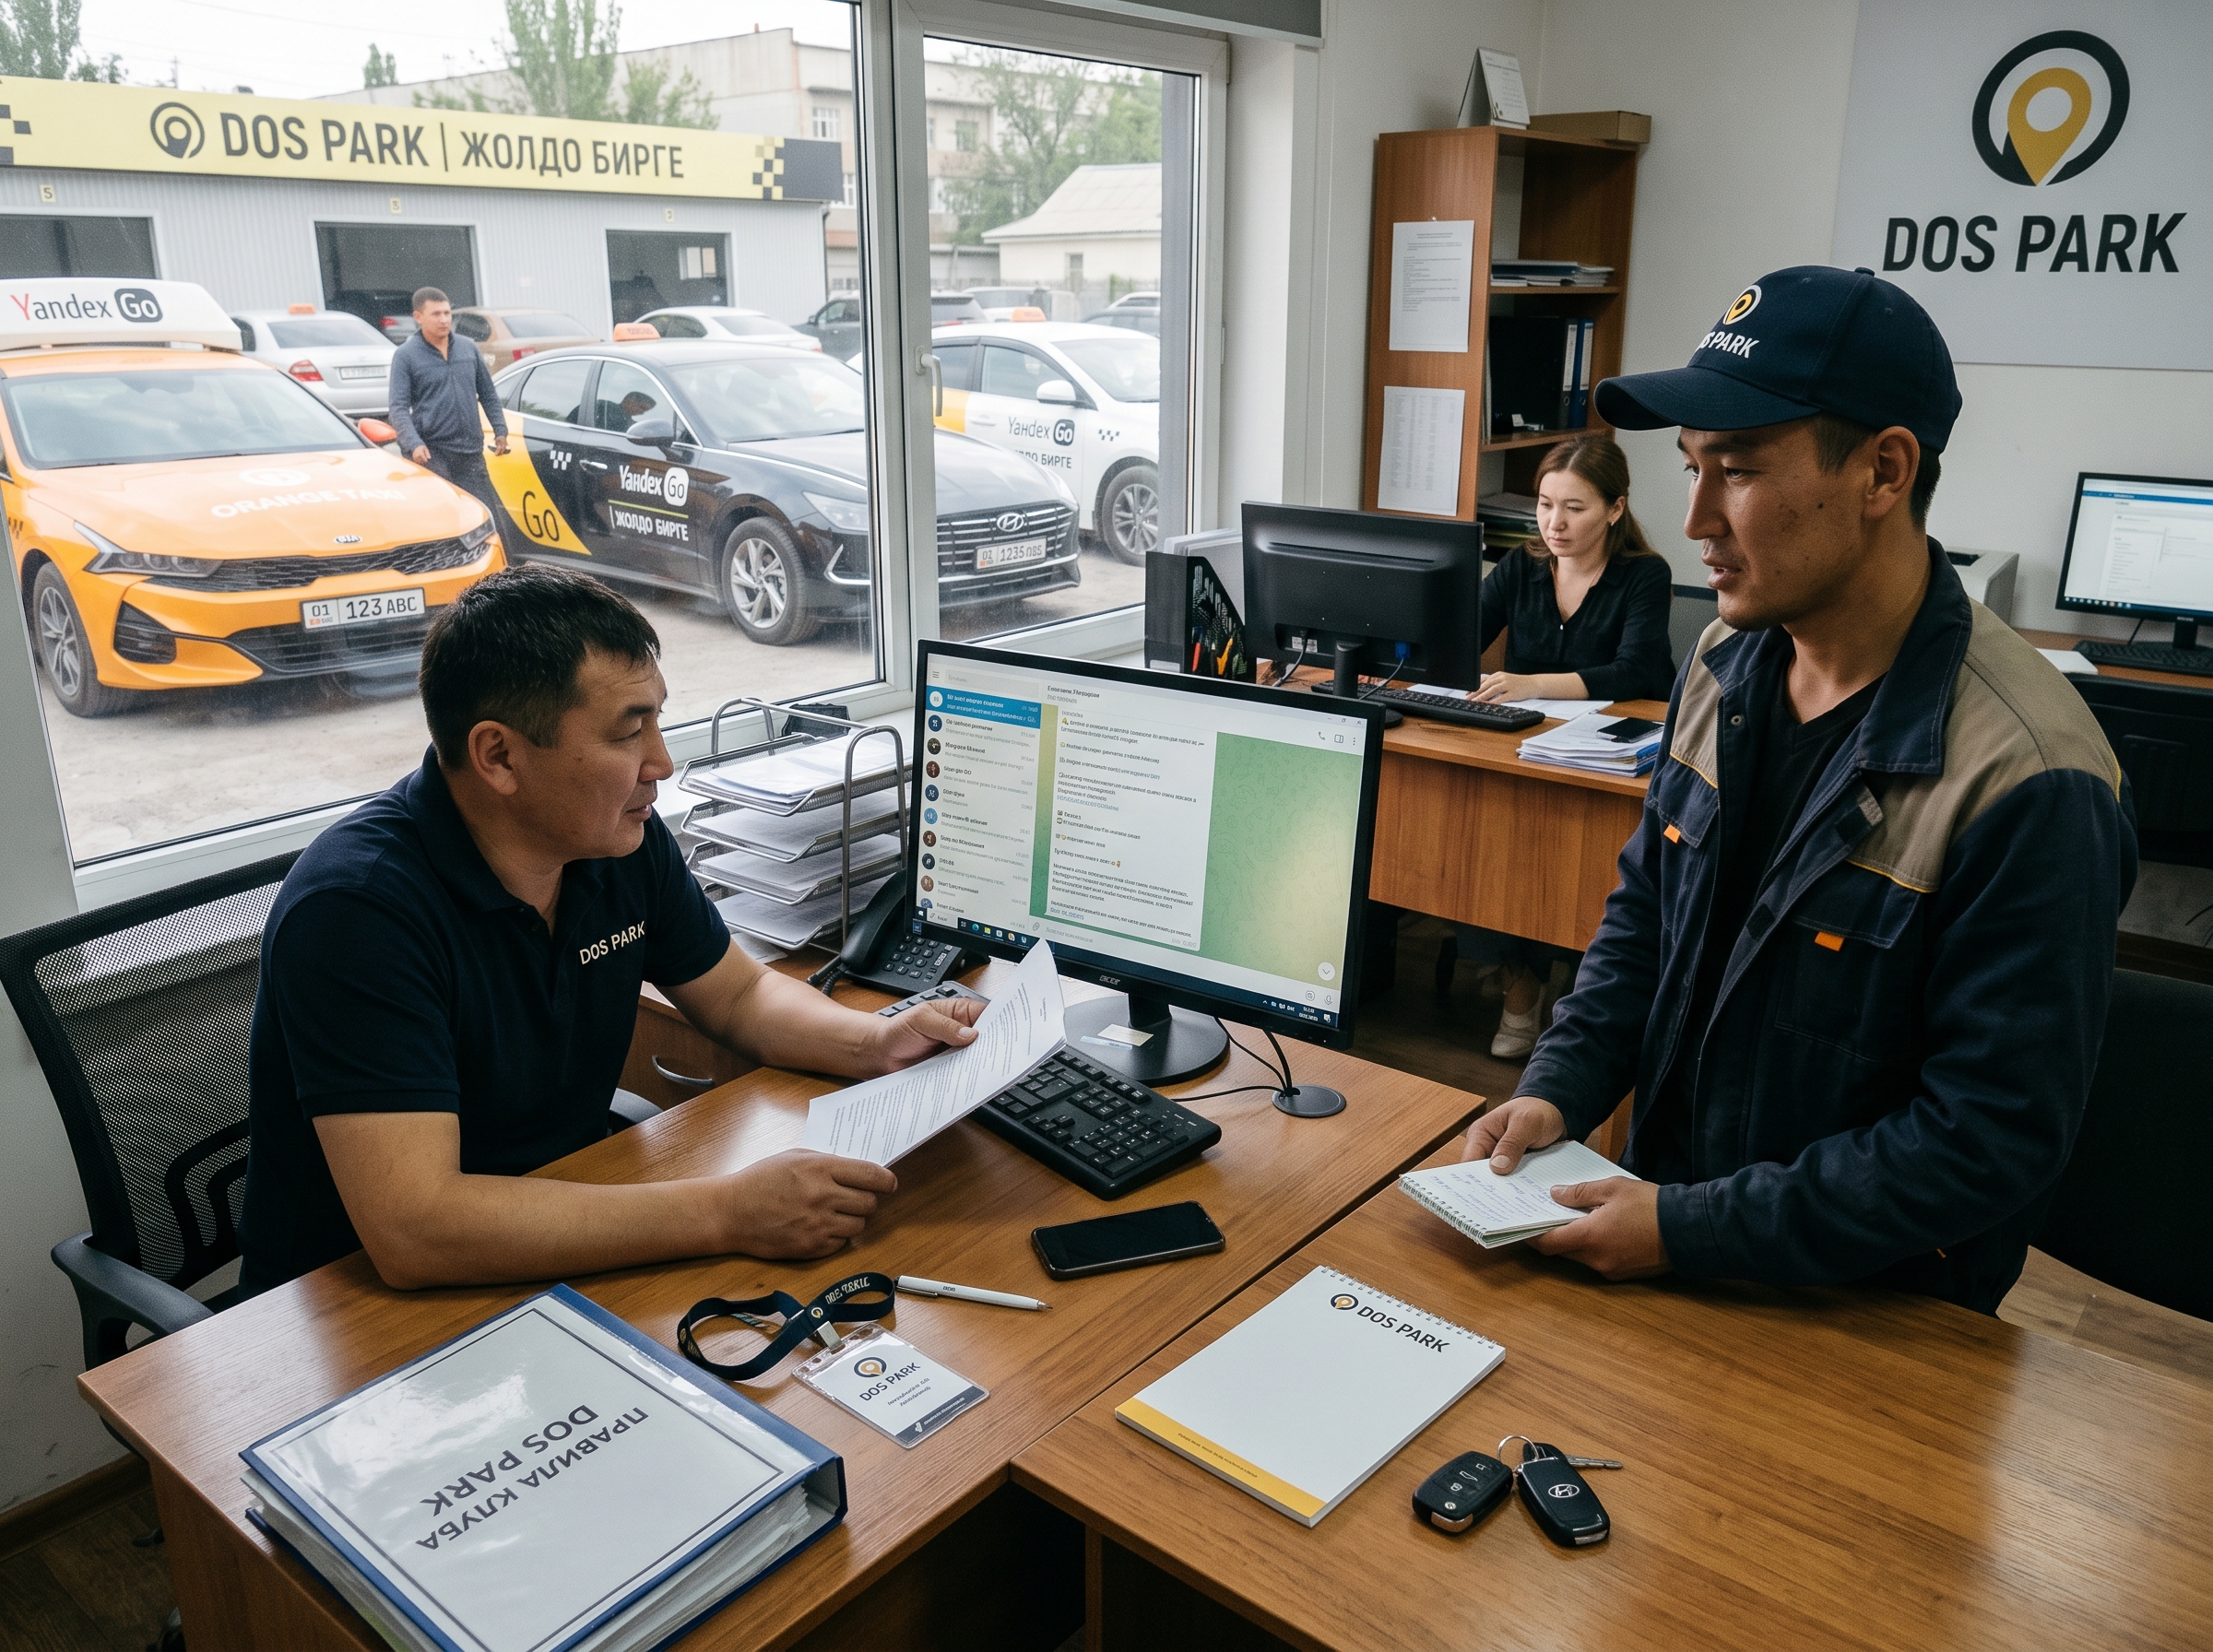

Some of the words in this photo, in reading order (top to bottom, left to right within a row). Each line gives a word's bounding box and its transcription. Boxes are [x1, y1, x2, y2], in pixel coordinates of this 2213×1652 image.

[219, 112, 309, 161] DOS
[321, 118, 430, 167] PARK
[459, 130, 582, 178] ЖОЛДО
[592, 140, 684, 179] БИРГЕ
[43, 187, 53, 199] 5
[1882, 215, 1998, 273] DOS
[2014, 212, 2188, 273] PARK
[10, 293, 112, 321] Yandex
[118, 291, 160, 320] Go
[1054, 421, 1074, 443] Go
[1041, 454, 1072, 469] БИРГЕ
[211, 490, 341, 518] ORANGE
[337, 489, 408, 502] TAXI
[667, 474, 686, 500] Go
[522, 490, 560, 542] Go
[614, 510, 654, 536] ЖОЛДО
[655, 518, 690, 542] БИРГЕ
[312, 604, 330, 617] 01
[346, 597, 383, 620] 123
[386, 596, 418, 615] ABC
[579, 939, 609, 965] DOS
[610, 920, 645, 950] PARK
[1356, 1305, 1398, 1328] DOS
[1395, 1323, 1450, 1353] PARK
[858, 1381, 888, 1401] DOS
[515, 1407, 649, 1488] ПРАВИЛА
[521, 1404, 599, 1455] DOS
[419, 1449, 523, 1517] PARK
[415, 1486, 519, 1550] КЛУБА
